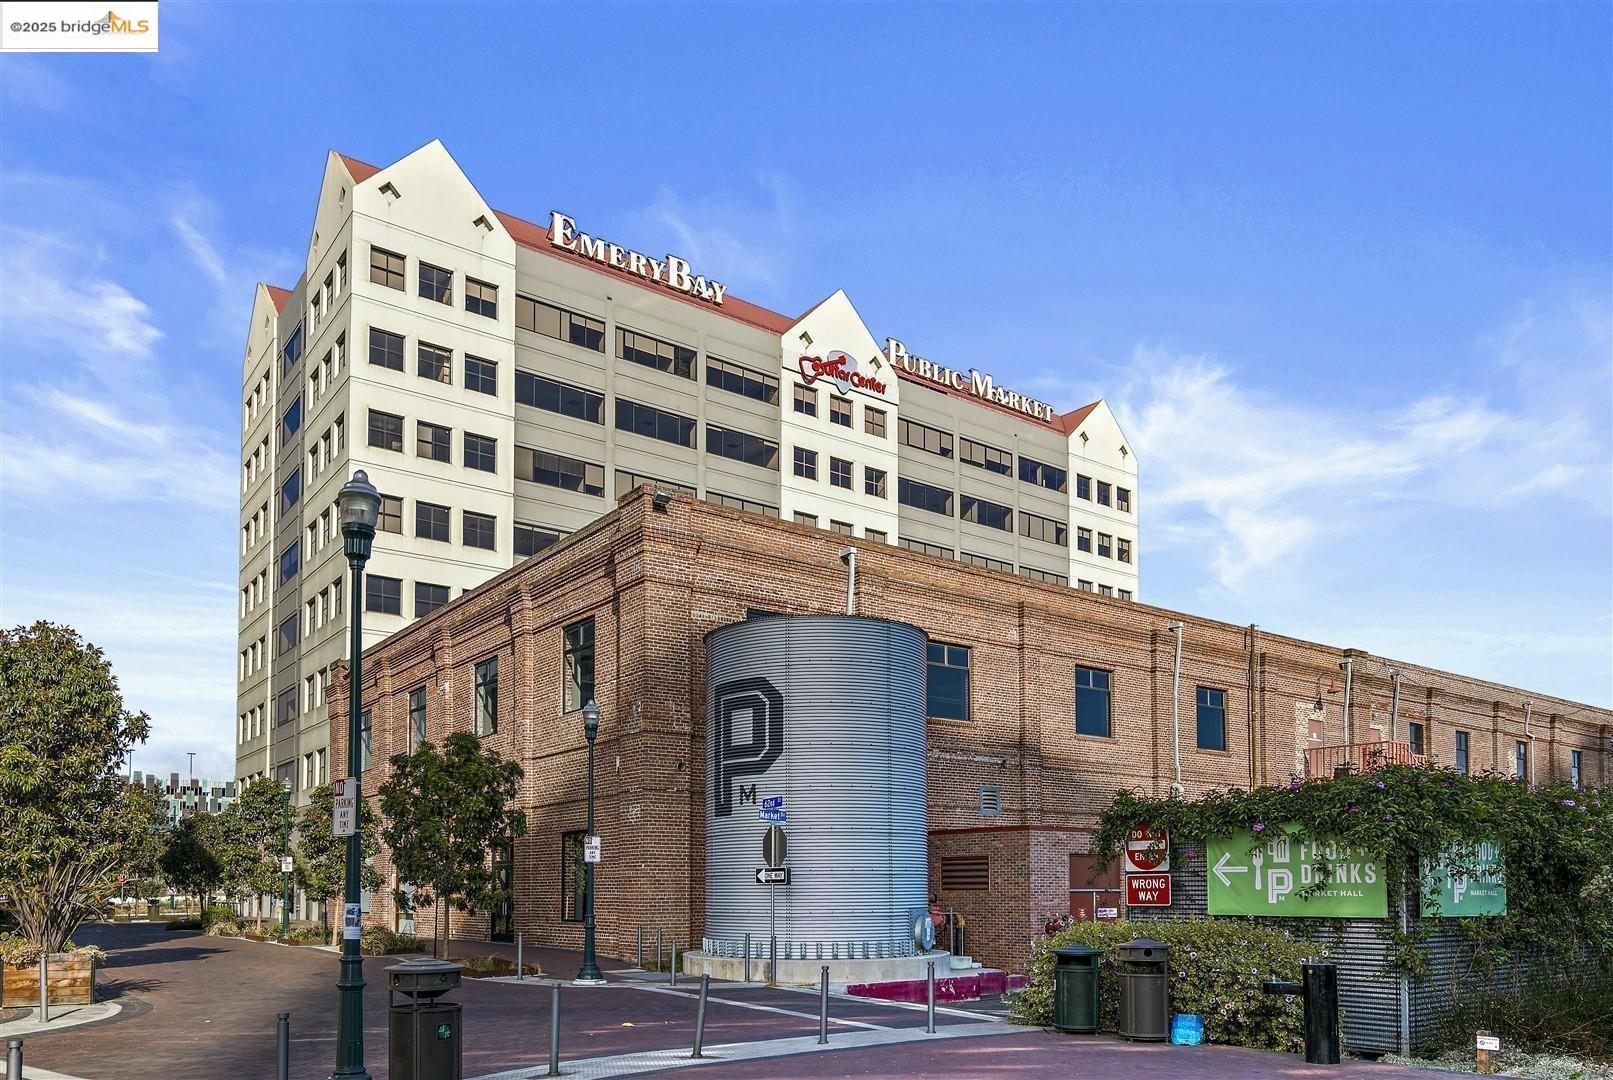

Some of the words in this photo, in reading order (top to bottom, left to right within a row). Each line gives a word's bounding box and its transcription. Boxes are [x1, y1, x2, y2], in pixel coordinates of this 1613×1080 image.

[850, 371, 887, 395] Center
[887, 337, 964, 390] PUBLIC
[969, 368, 1054, 422] MARKET
[336, 782, 344, 794] NO
[739, 784, 757, 805] M
[335, 798, 354, 809] PARKING
[760, 811, 780, 820] Market
[1131, 879, 1166, 889] WRONG
[1138, 891, 1159, 901] WAY
